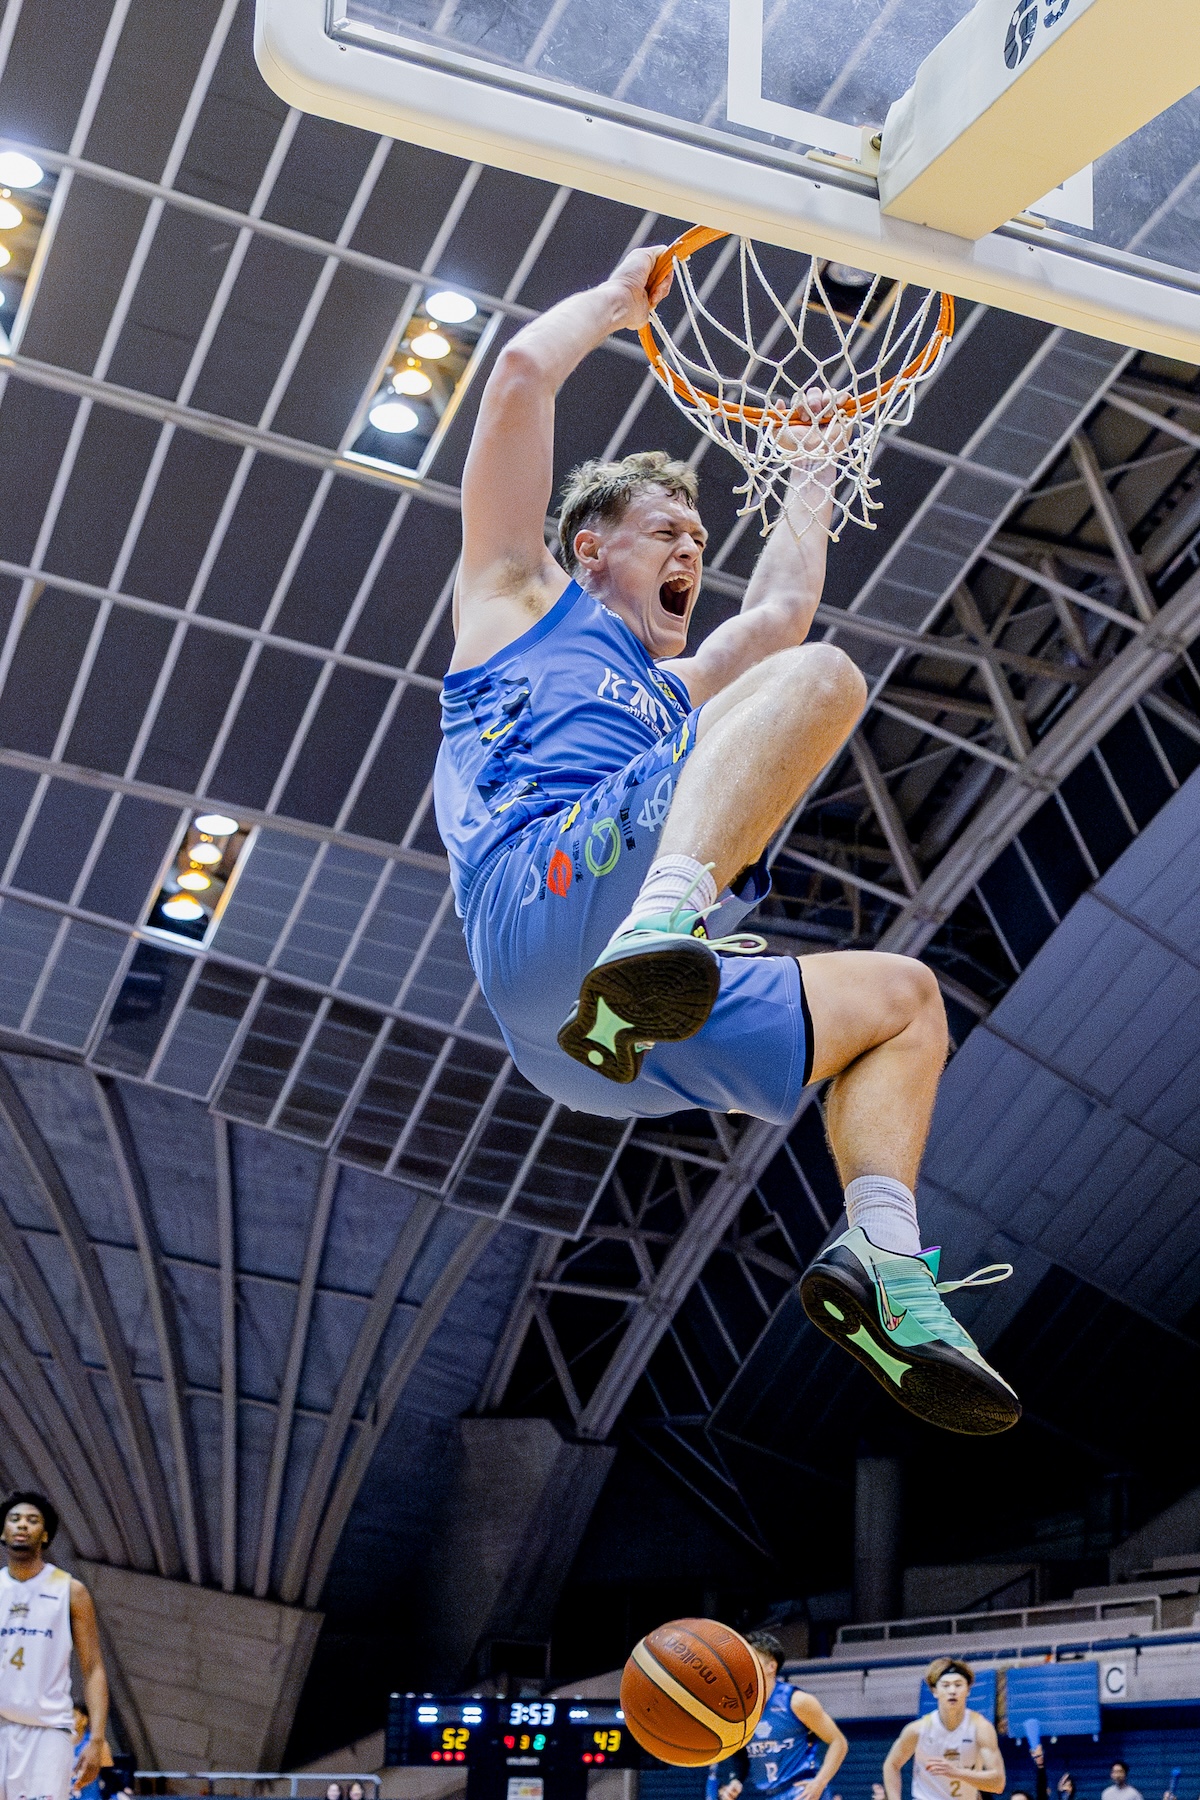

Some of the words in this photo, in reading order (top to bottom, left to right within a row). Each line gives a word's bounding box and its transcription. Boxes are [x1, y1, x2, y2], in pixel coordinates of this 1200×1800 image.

[10, 1647, 25, 1670] 4
[664, 1636, 718, 1685] molten
[1105, 1667, 1125, 1694] C
[509, 1703, 556, 1725] 3:53
[442, 1728, 470, 1750] 52
[519, 1734, 530, 1750] 3
[533, 1733, 546, 1750] 2
[593, 1729, 621, 1752] 43
[950, 1780, 962, 1797] 2
